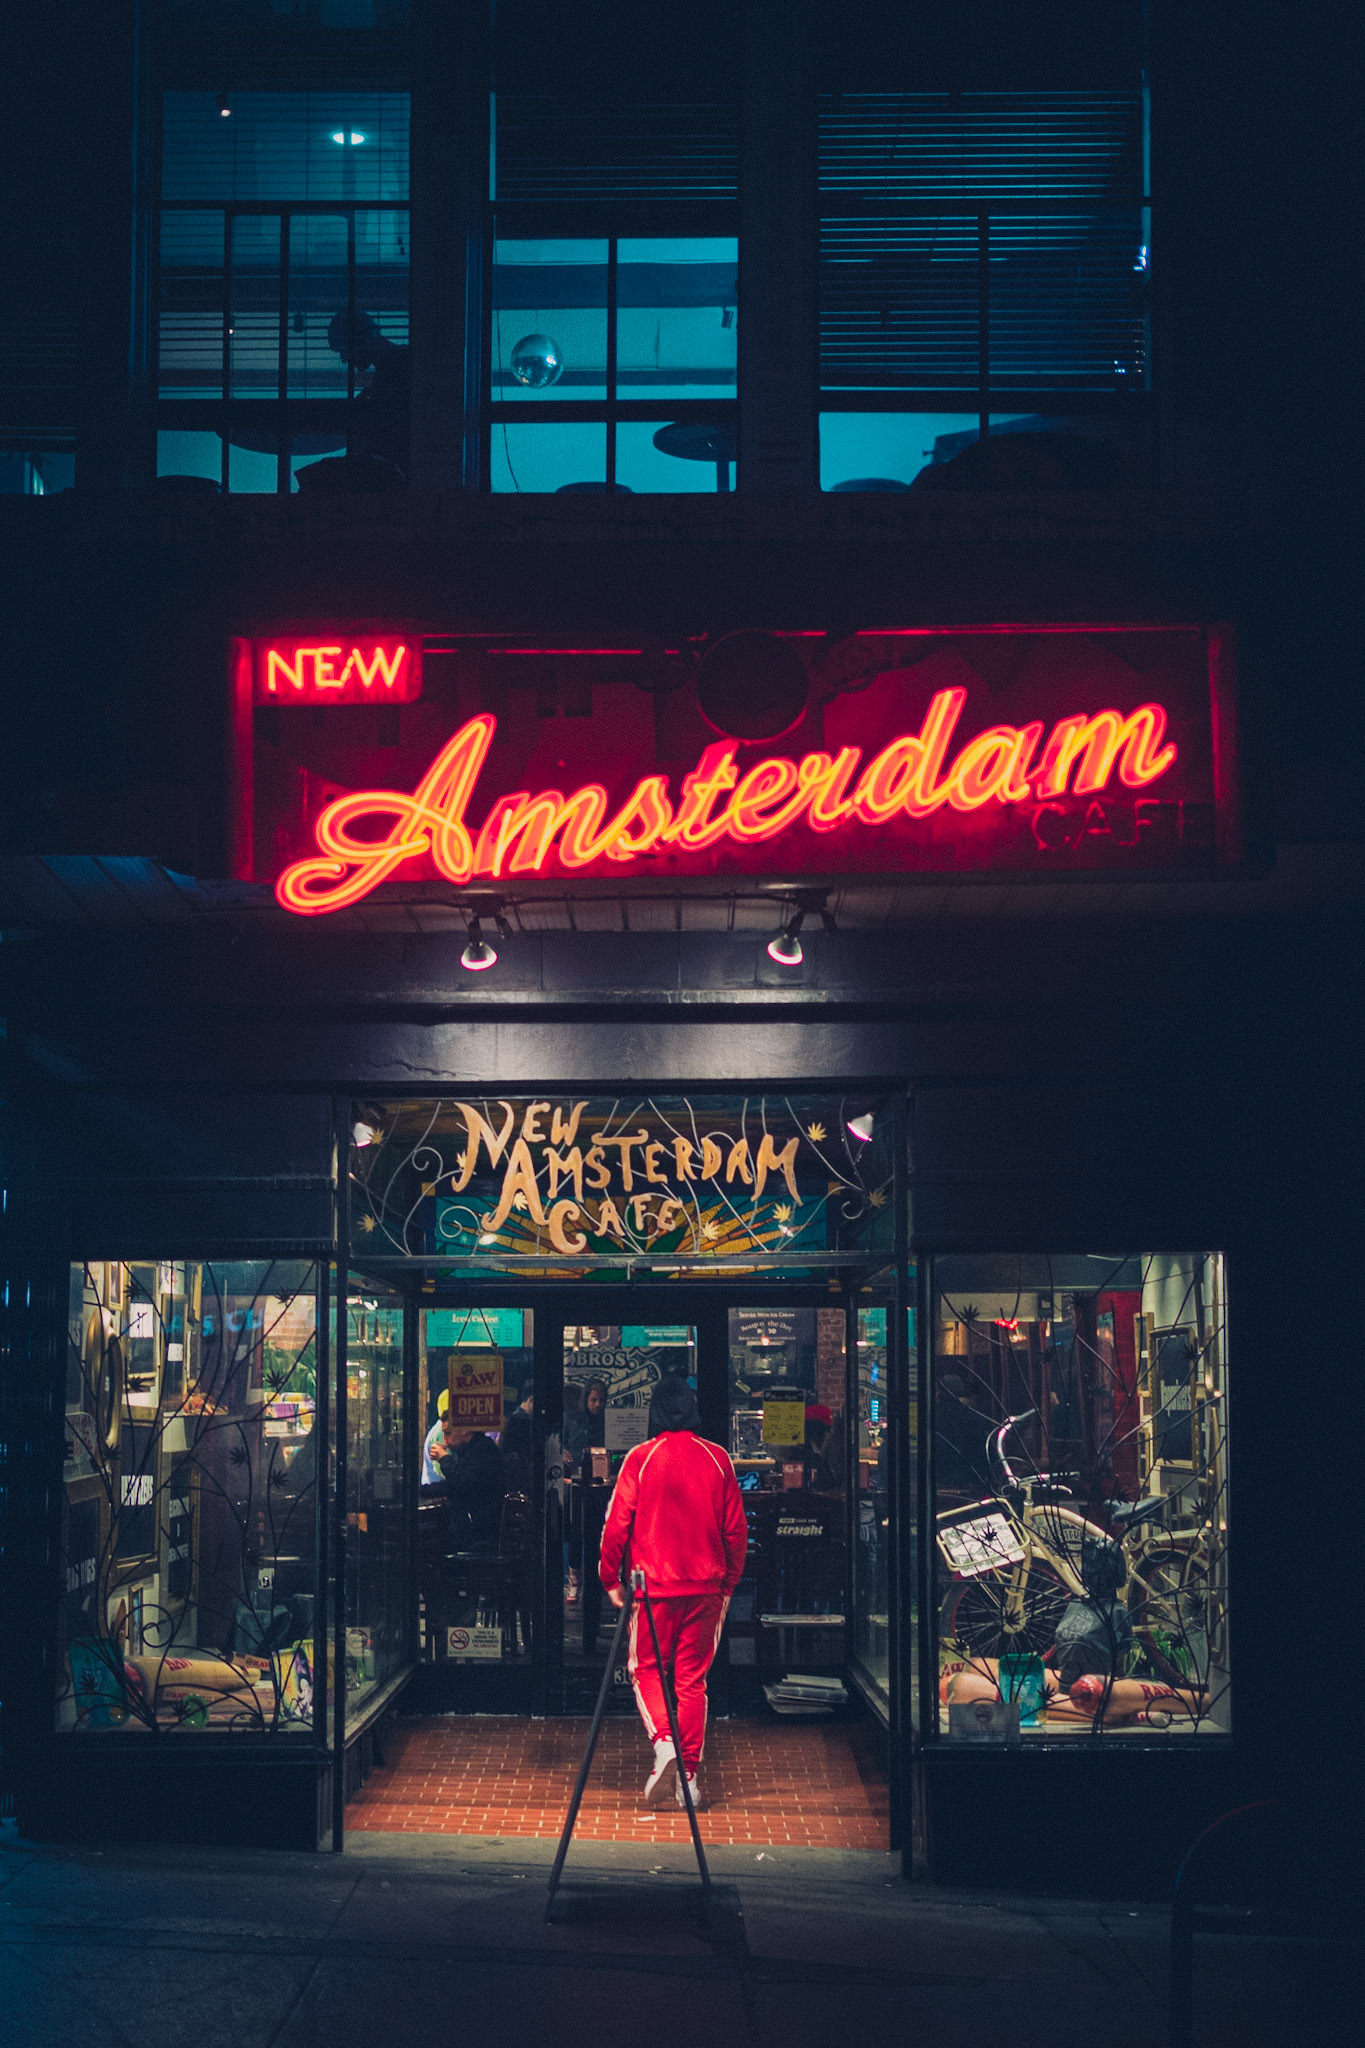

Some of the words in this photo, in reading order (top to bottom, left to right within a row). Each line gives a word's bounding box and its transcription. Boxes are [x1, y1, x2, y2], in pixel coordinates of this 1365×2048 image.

[267, 646, 406, 691] NEW
[275, 687, 1178, 915] Amsterdam
[452, 1101, 589, 1192] NEW
[482, 1129, 803, 1231] AMSTERDAM
[548, 1194, 683, 1254] CAFE
[456, 1371, 497, 1389] RAW
[458, 1397, 495, 1415] OPEN
[776, 1525, 823, 1536] straight
